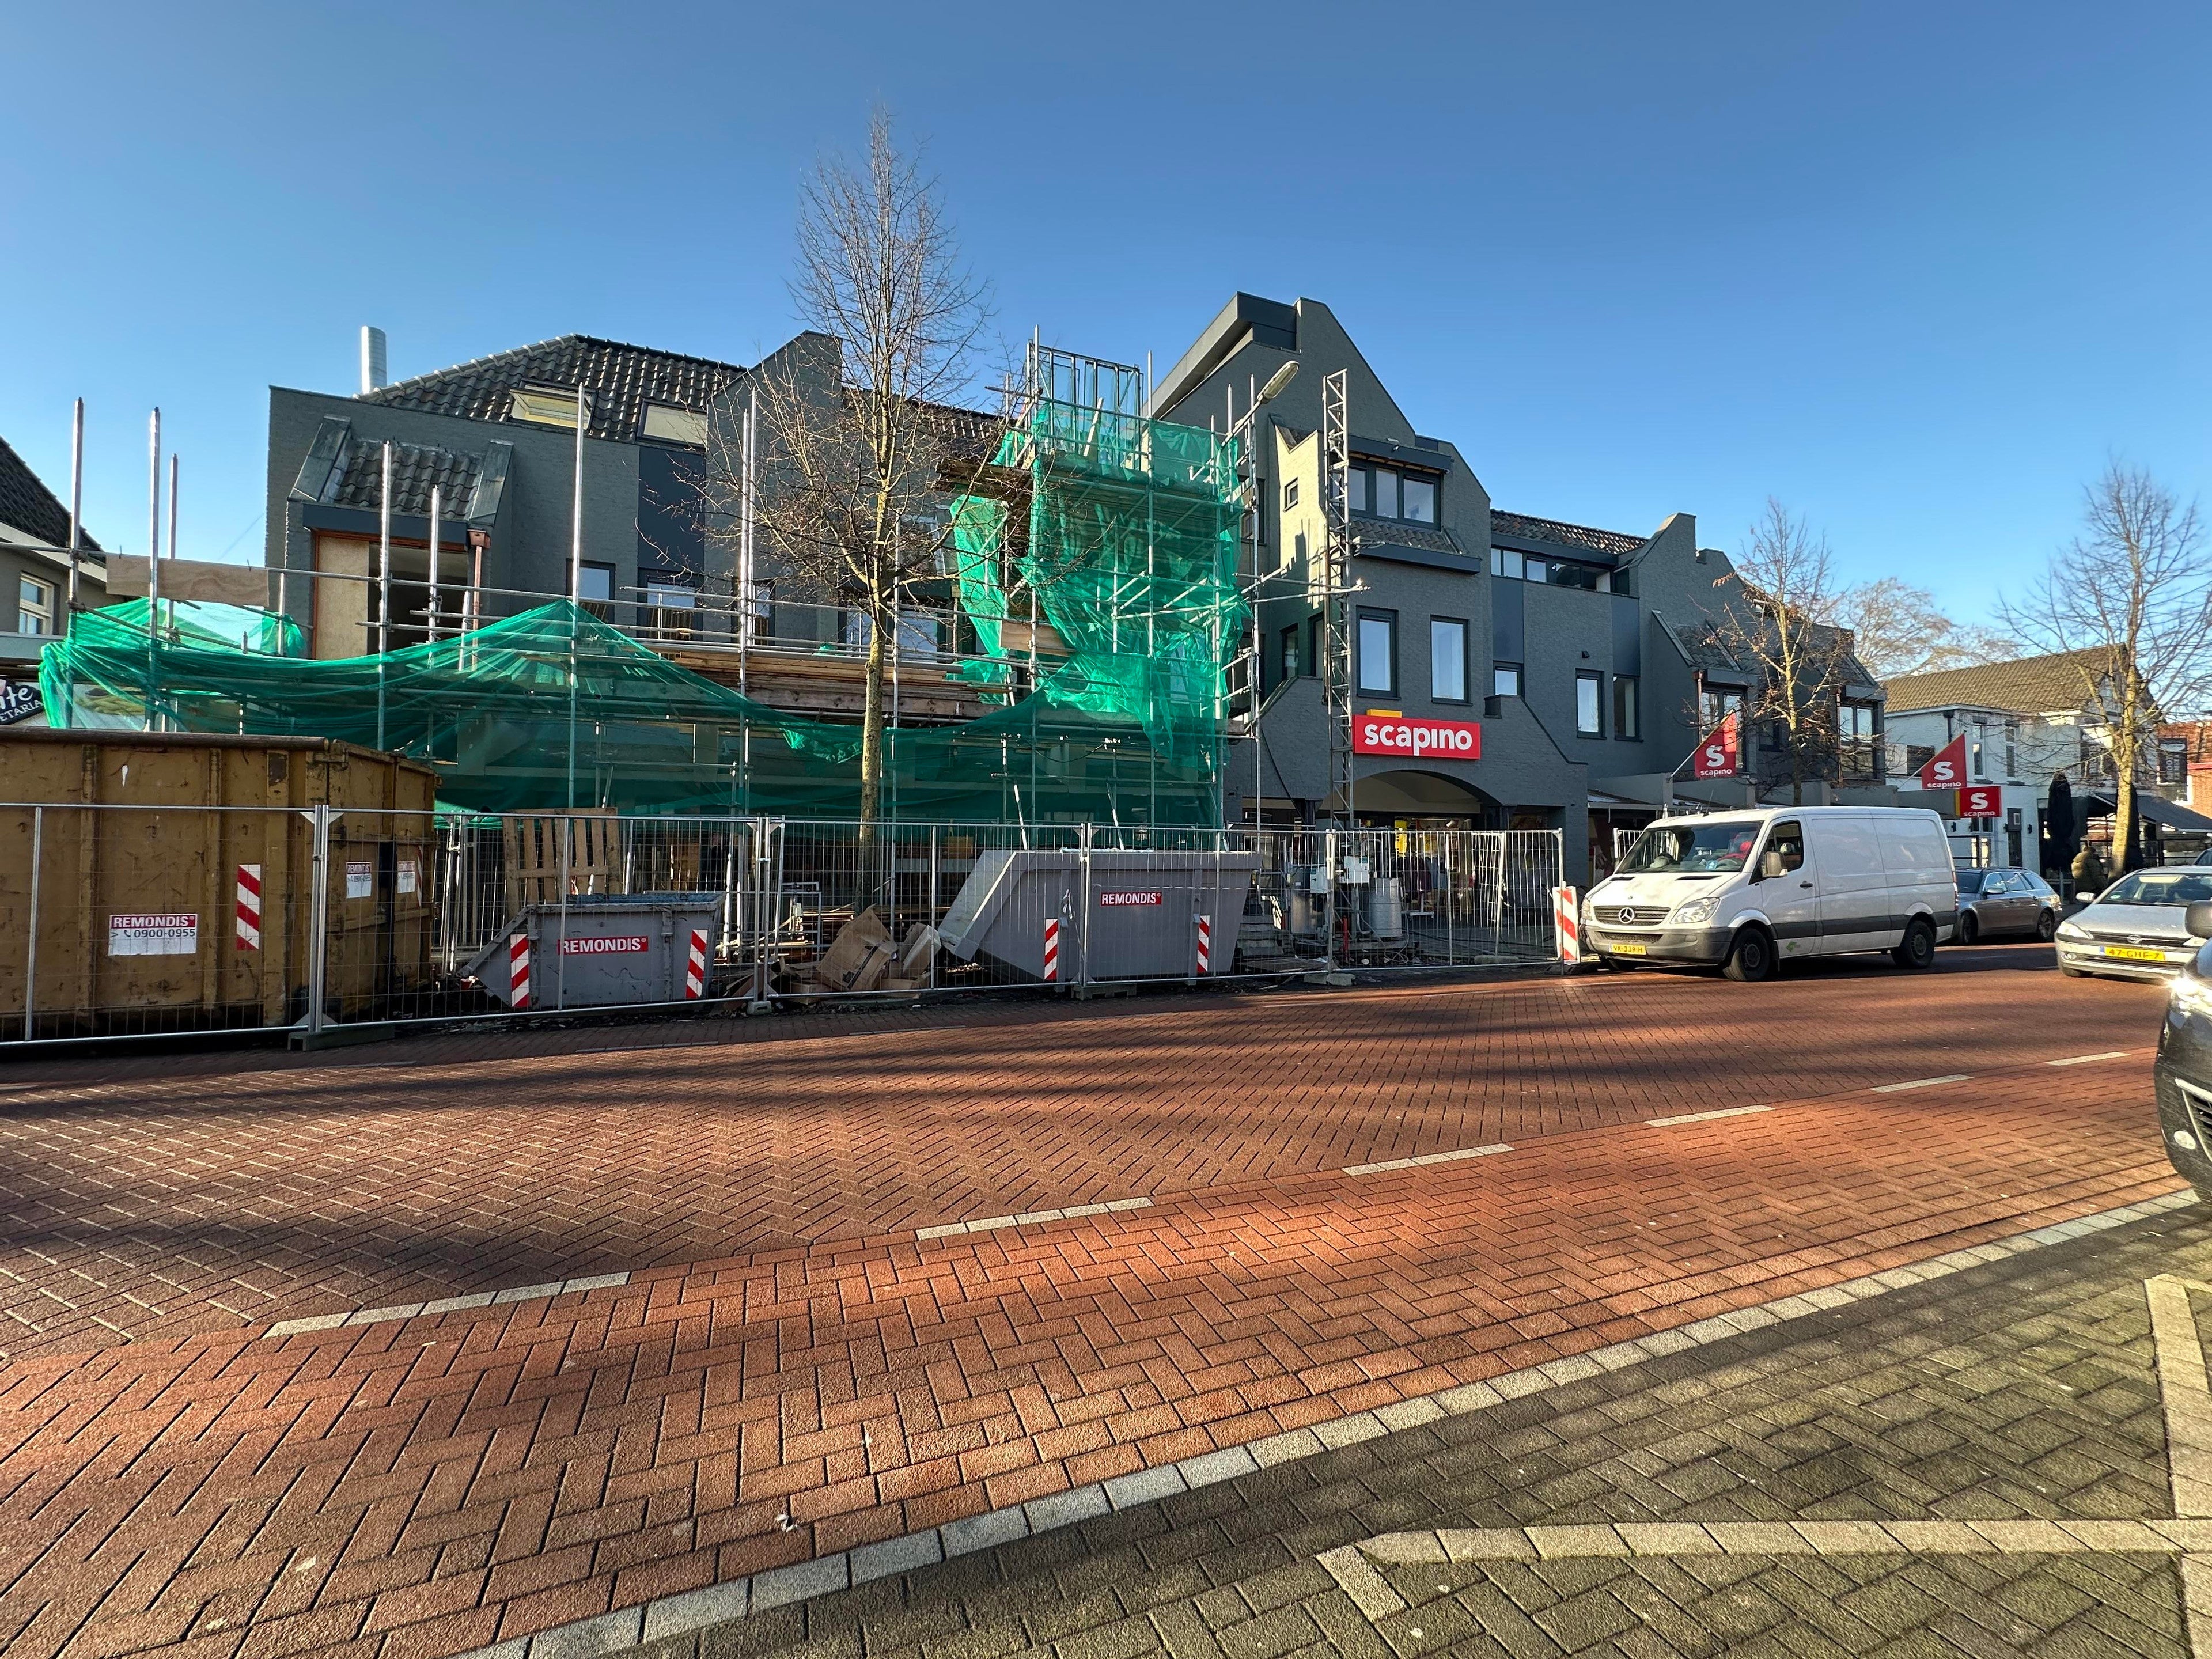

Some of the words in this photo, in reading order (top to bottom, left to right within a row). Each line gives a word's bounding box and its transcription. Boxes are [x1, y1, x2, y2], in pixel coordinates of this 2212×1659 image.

[1364, 724, 1472, 756] scapino
[1101, 893, 1157, 904] REMONDIS
[113, 916, 189, 927] REMONDIS
[134, 929, 195, 938] 0900-0955
